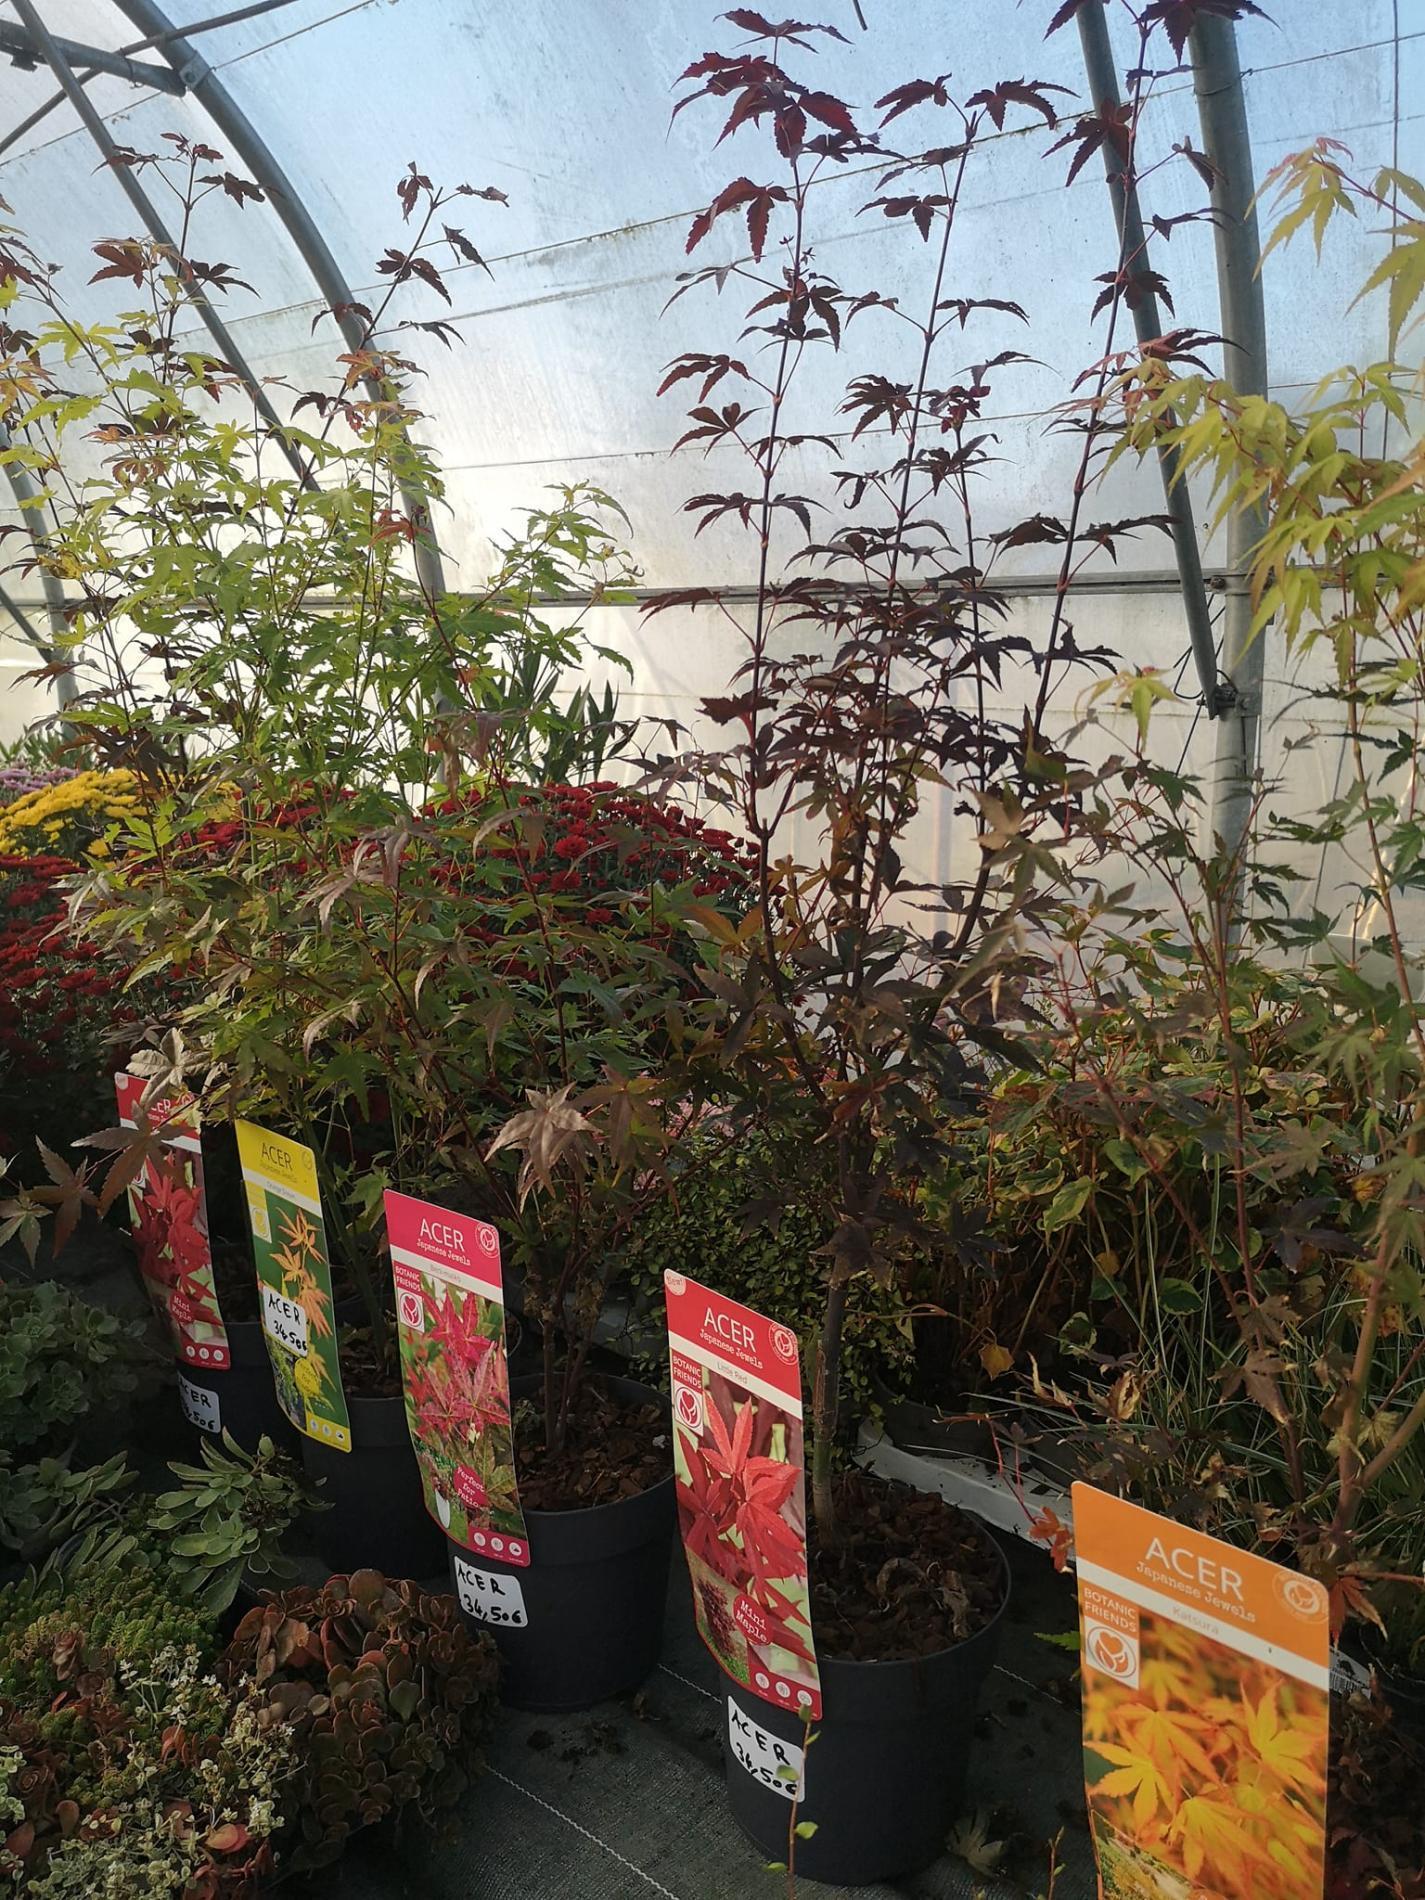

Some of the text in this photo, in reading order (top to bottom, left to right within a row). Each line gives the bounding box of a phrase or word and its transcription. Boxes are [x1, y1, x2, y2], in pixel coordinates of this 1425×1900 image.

[261, 1142, 293, 1171] ACER
[420, 1218, 465, 1252] ACER
[417, 1238, 471, 1266] Japanese Jewels
[395, 1265, 420, 1281] BOTANIC
[396, 1276, 421, 1291] FRIENDS
[173, 1295, 191, 1313] Mini
[268, 1293, 301, 1326] ACER
[703, 1307, 756, 1353] ACER
[700, 1328, 763, 1370] Japanese Jewels
[672, 1355, 702, 1379] BOTANIC
[673, 1366, 702, 1390] FRIENDS
[457, 1466, 485, 1493] Perfect
[463, 1482, 476, 1496] for
[458, 1564, 506, 1596] ACER
[1145, 1537, 1245, 1601] ACER
[1083, 1587, 1137, 1619] BOTANIC
[1135, 1561, 1201, 1599] Japanese
[1204, 1590, 1257, 1624] Jewels
[463, 1593, 522, 1624] 34,50€
[740, 1600, 767, 1630] Mini
[1083, 1602, 1137, 1633] FRIENDS
[1171, 1604, 1220, 1636] Katsura
[735, 1610, 768, 1644] Maple
[731, 1709, 791, 1766] ACER
